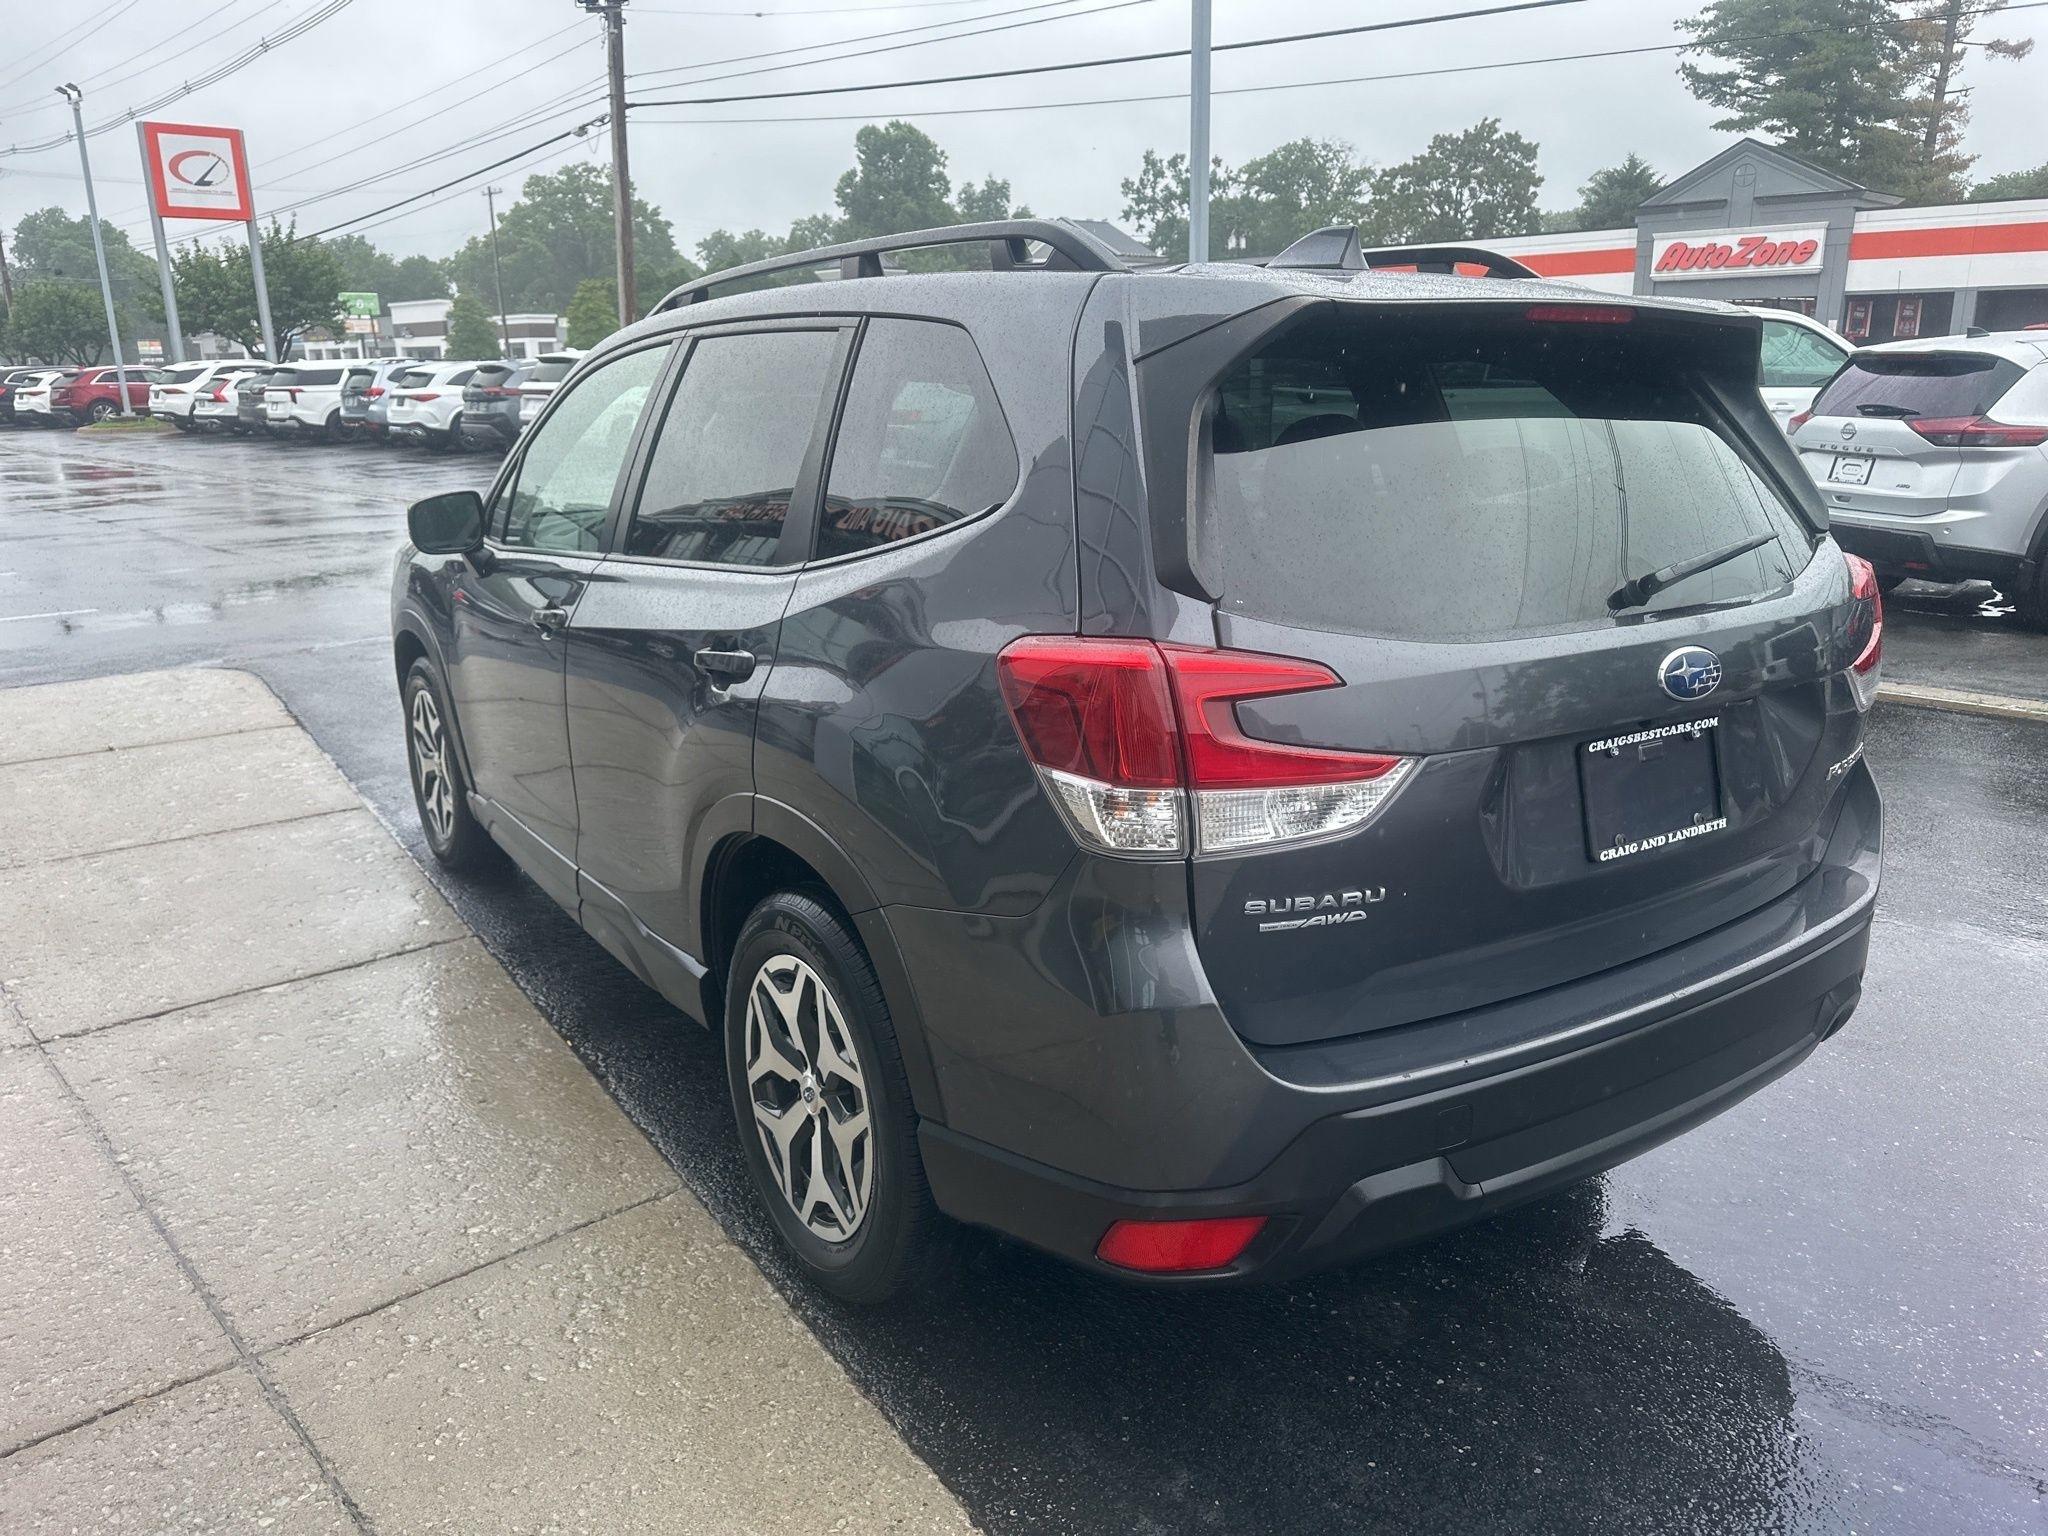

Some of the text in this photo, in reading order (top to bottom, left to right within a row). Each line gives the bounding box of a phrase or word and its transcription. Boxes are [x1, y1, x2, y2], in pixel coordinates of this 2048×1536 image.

[1654, 236, 1818, 271] AutoZone
[1588, 716, 1719, 753] CRAIGSBESTCARS.COM
[1599, 817, 1728, 862] CRAIG AND LANDRETH
[1244, 886, 1386, 915] SUBARU
[1300, 910, 1368, 928] AWD
